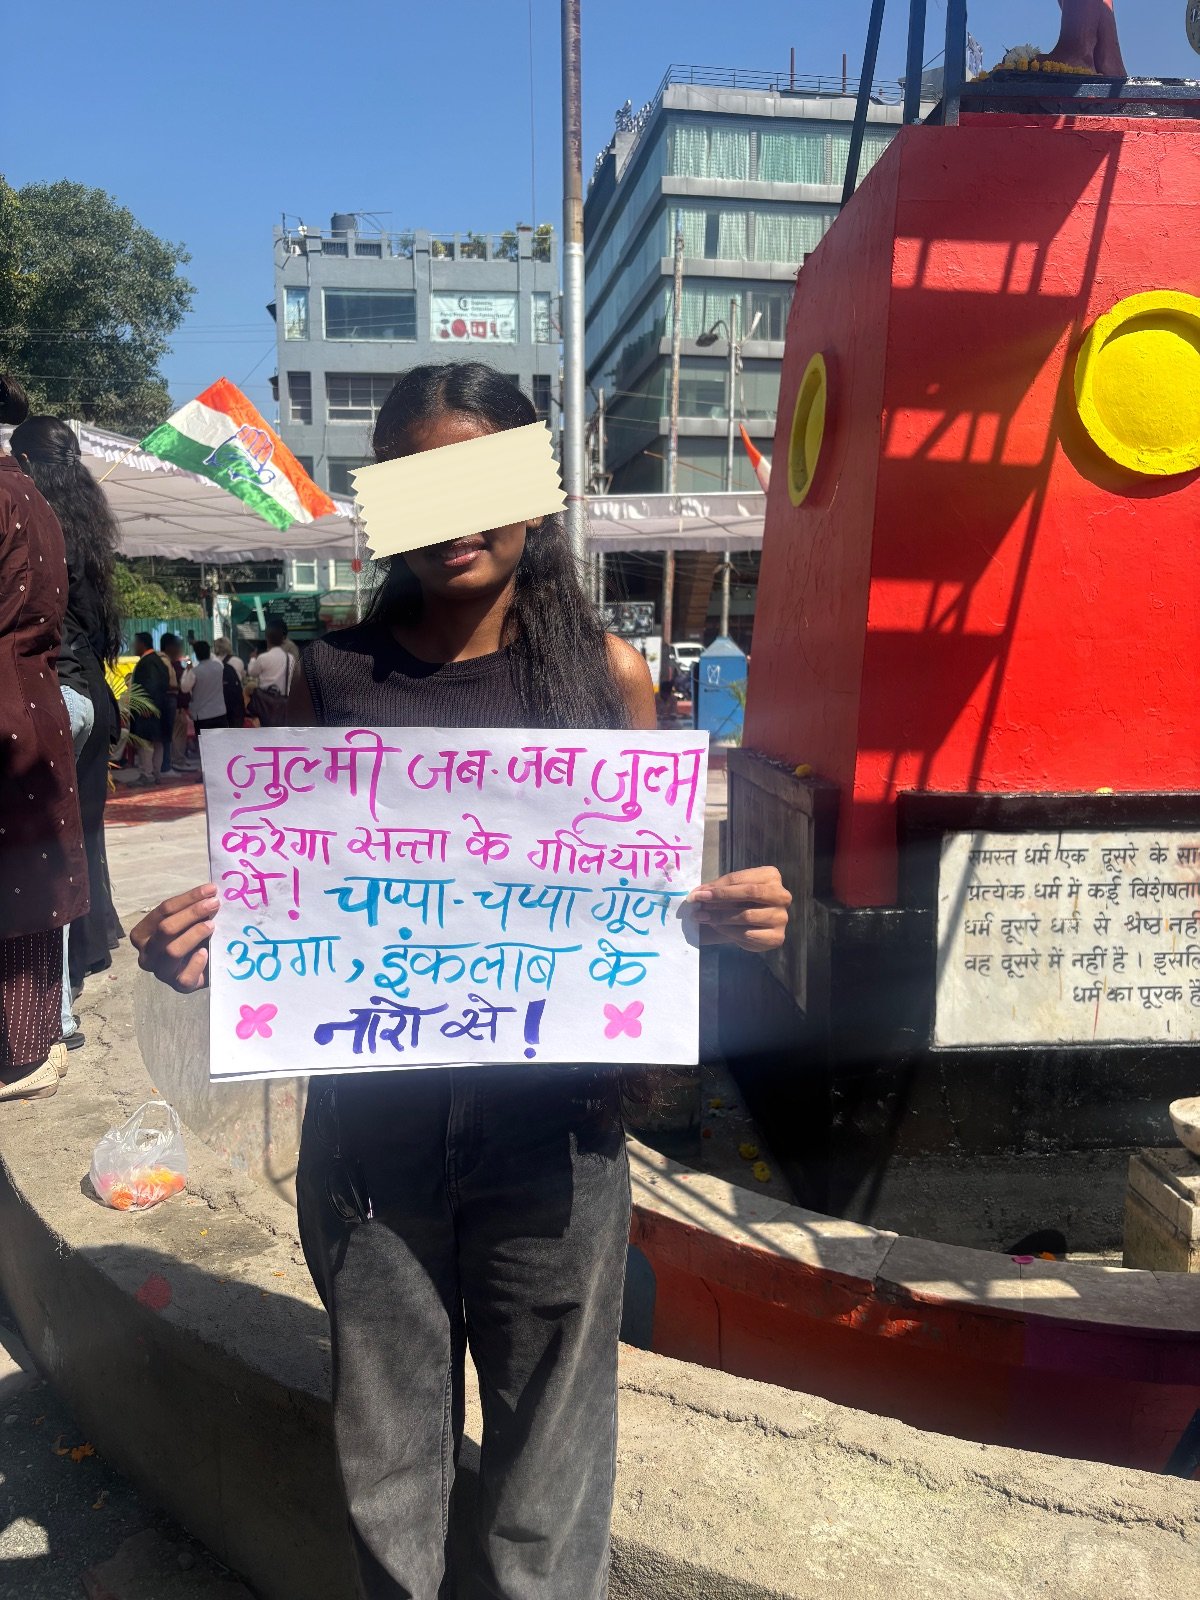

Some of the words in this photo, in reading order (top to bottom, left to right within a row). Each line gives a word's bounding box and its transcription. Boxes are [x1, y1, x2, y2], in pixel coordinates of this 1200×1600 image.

[222, 817, 337, 866] करेगा
[347, 826, 452, 868] सत्ता
[462, 812, 512, 865] के
[527, 829, 693, 883] गलियारों
[967, 849, 1018, 866] समस्त
[1024, 842, 1051, 865] धर्म
[1057, 848, 1089, 869] एक
[1101, 841, 1139, 873] दूसरे
[1149, 841, 1169, 864] के
[967, 878, 1026, 902] प्रत्येक
[1034, 876, 1063, 900] धर्म
[1067, 876, 1083, 898] में
[1087, 875, 1122, 906] कई
[964, 912, 994, 936] धर्म
[1001, 912, 1041, 945] दूसरे
[1050, 910, 1082, 935] धर्म
[1093, 911, 1111, 936] से
[1124, 911, 1163, 935] श्रेष्ठ
[374, 926, 583, 999] इंकलाब
[589, 937, 661, 989] के
[964, 954, 994, 977] वह
[1001, 947, 1042, 979] दूसरे
[1047, 946, 1065, 969] में
[1071, 945, 1108, 976] नहीं
[1112, 945, 1128, 974] है
[1072, 979, 1102, 1003] धर्म
[1106, 986, 1134, 1003] का
[1137, 985, 1183, 1010] पूरक
